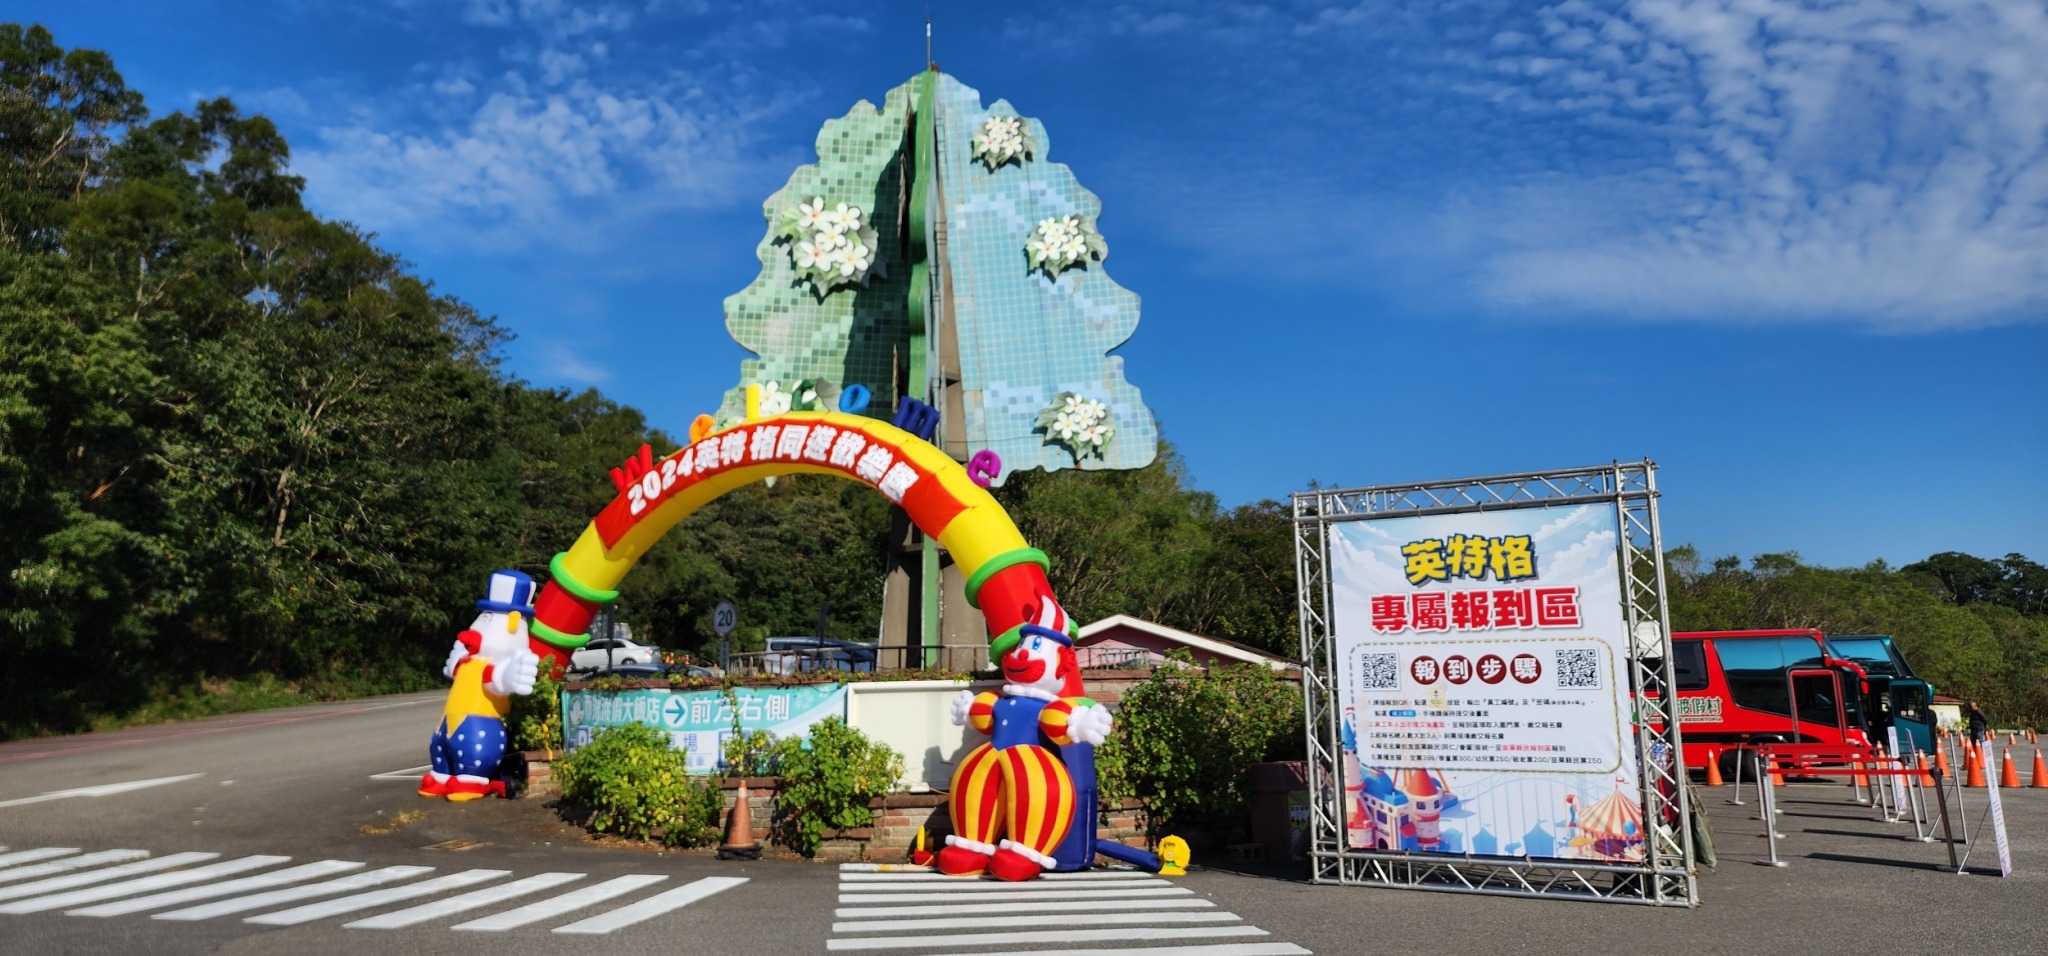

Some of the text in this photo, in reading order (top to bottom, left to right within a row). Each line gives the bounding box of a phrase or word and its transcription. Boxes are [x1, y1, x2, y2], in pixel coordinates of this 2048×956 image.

[1401, 534, 1535, 586] 英特格
[717, 609, 733, 627] 20
[1371, 587, 1580, 631] 專屬報到區
[1413, 656, 1539, 681] 報到步驟
[691, 694, 790, 724] 前方右側
